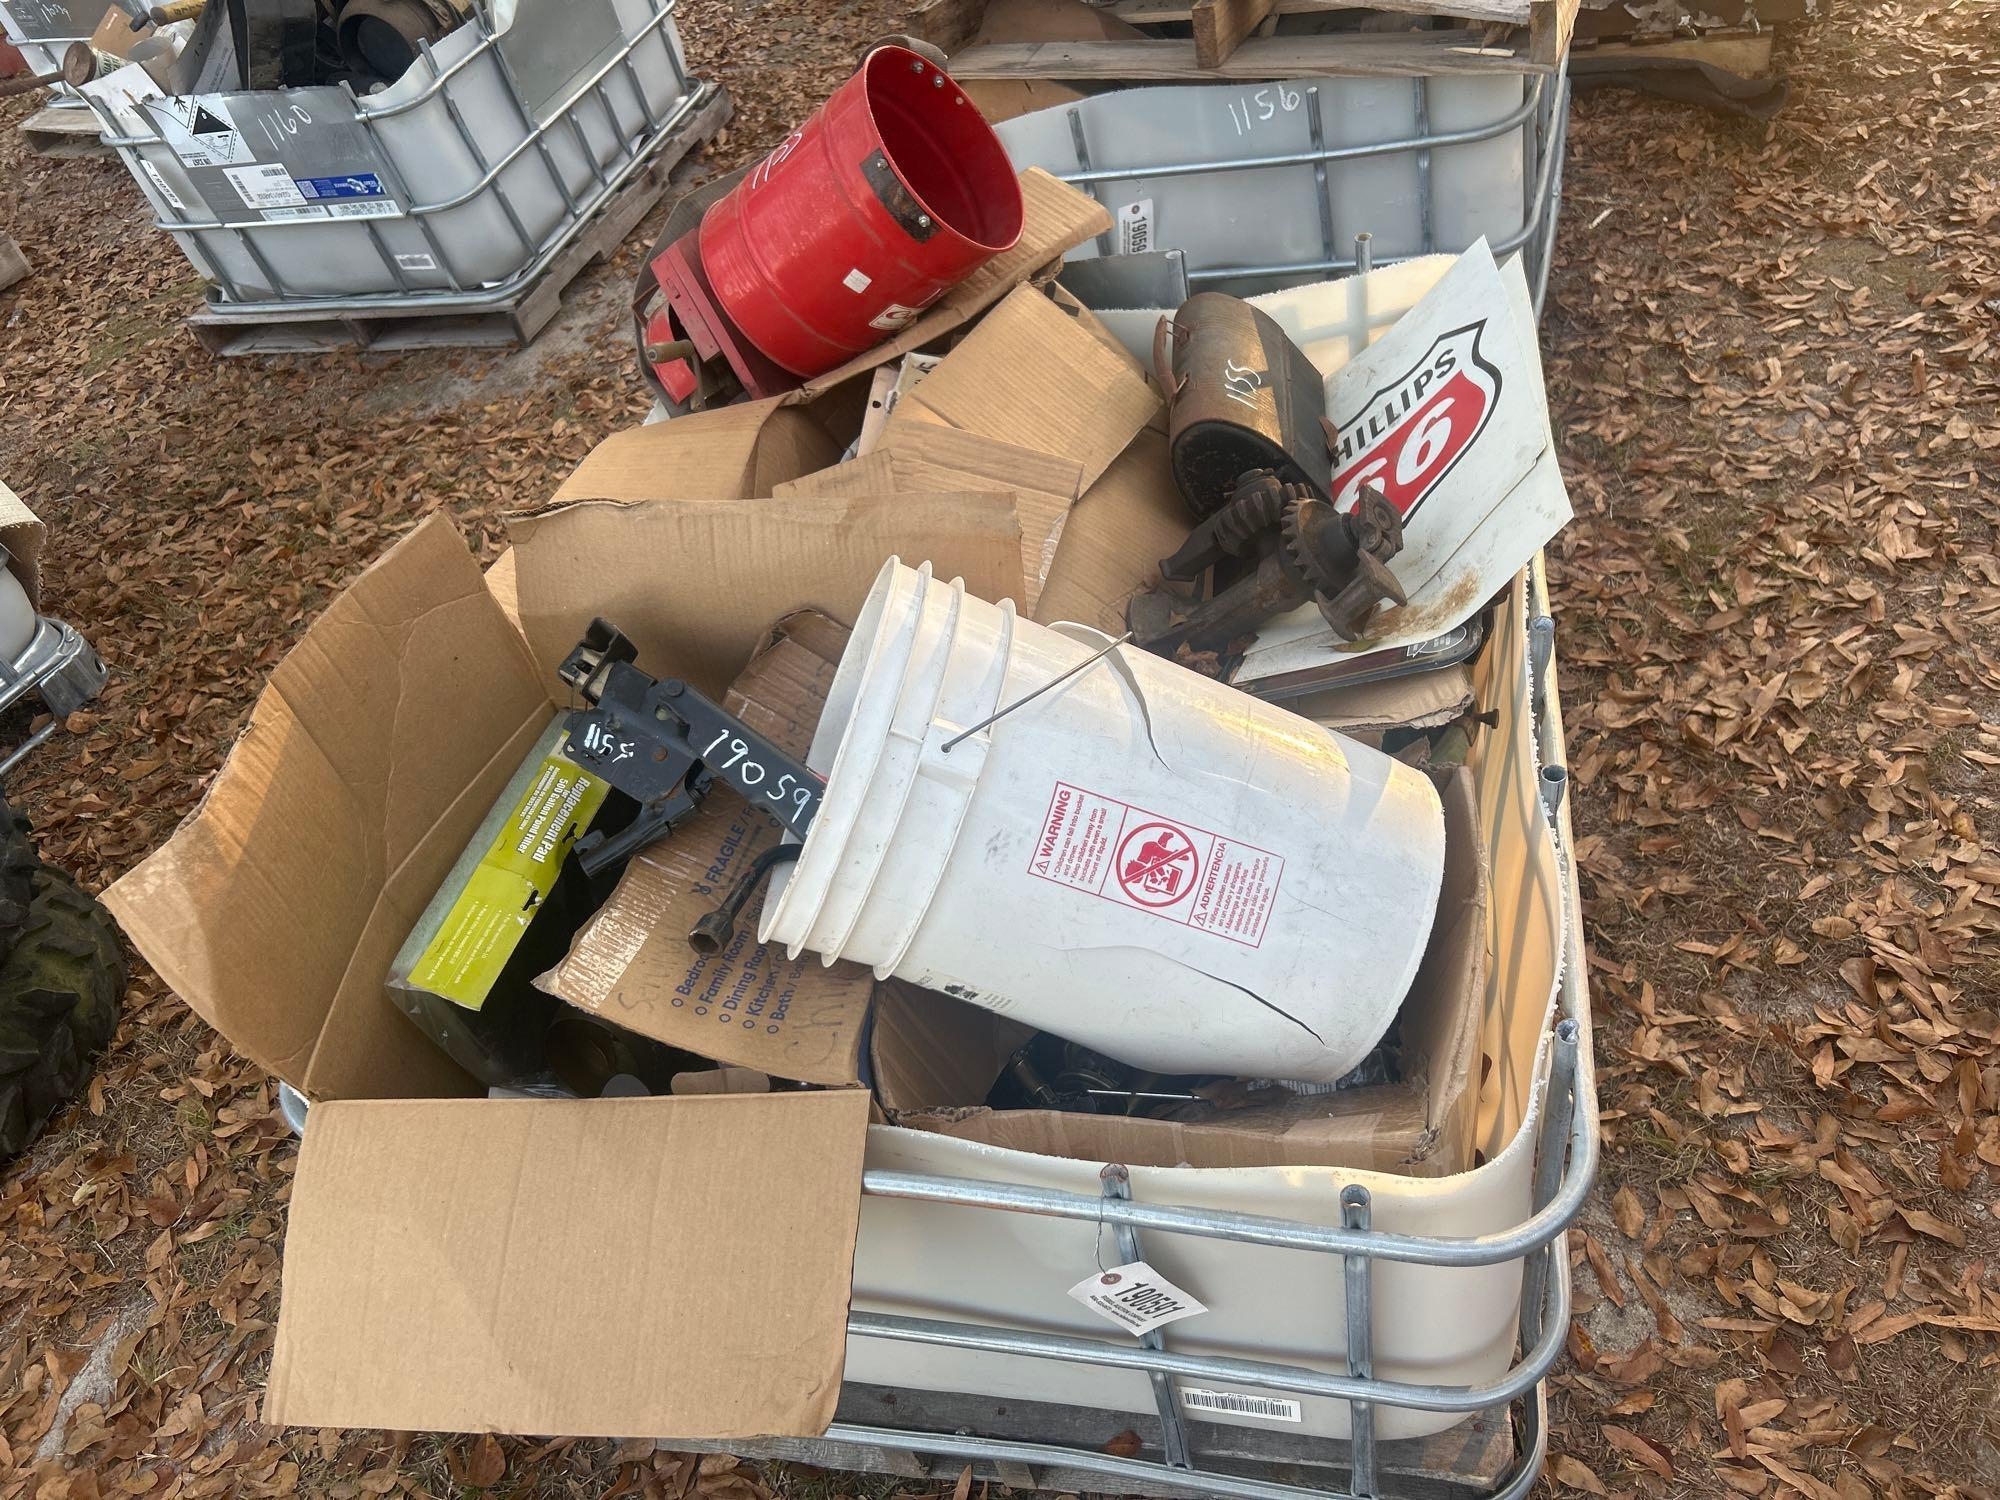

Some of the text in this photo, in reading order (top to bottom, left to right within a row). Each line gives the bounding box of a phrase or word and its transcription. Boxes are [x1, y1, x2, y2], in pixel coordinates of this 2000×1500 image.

[257, 105, 312, 151] 1160
[1228, 84, 1300, 136] 1156
[1131, 216, 1148, 254] 19059
[1224, 359, 1262, 410] 1155
[1331, 348, 1457, 469] HILLIPS
[1333, 397, 1455, 516] 66
[560, 788, 570, 799] for
[702, 728, 824, 836] 19059
[517, 777, 568, 854] 500 Gallon Pond Filter
[531, 776, 591, 863] Replacement Pad
[1039, 788, 1072, 859] WARNING
[704, 823, 746, 884] FRAGILE
[1199, 841, 1227, 910] ADVERTENCIA
[674, 953, 711, 996] Bedroo
[698, 963, 735, 1004] Family
[721, 928, 750, 963] Room
[722, 970, 757, 1011] Dining
[746, 970, 780, 1017] Kitchen
[770, 988, 796, 1022] Bath
[1114, 1282, 1186, 1319] 190591
